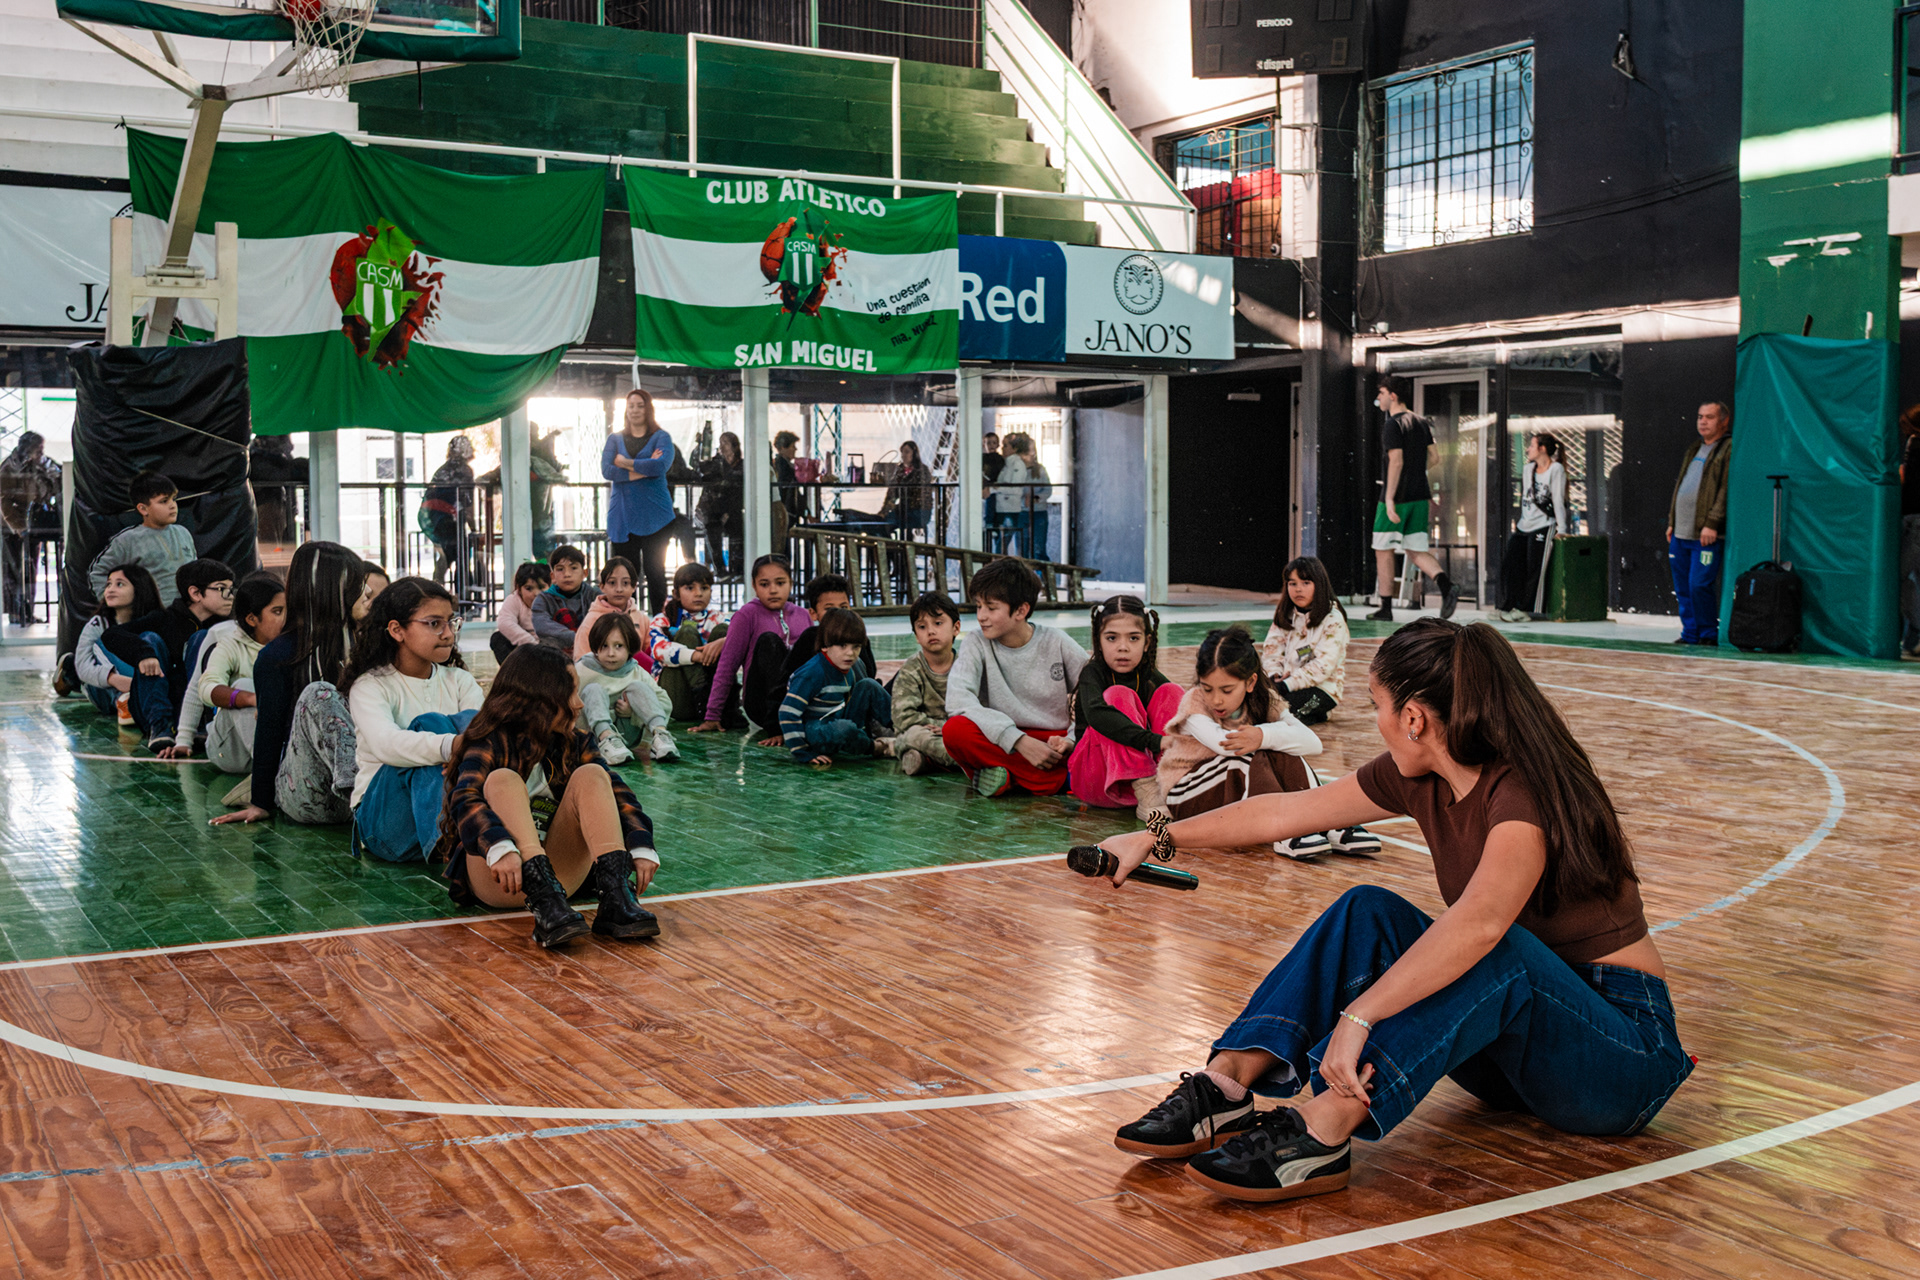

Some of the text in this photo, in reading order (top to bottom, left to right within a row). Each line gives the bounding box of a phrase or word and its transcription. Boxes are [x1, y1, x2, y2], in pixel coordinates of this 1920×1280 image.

[1256, 18, 1293, 28] PERIODO
[706, 179, 886, 217] CLUB ATLETICO
[787, 241, 817, 255] CASM
[357, 261, 403, 290] CASM
[866, 298, 887, 312] Una
[958, 271, 1045, 324] Red
[878, 311, 891, 324] de
[1084, 320, 1192, 355] JANO'S
[734, 340, 877, 372] SAN MIGUEL
